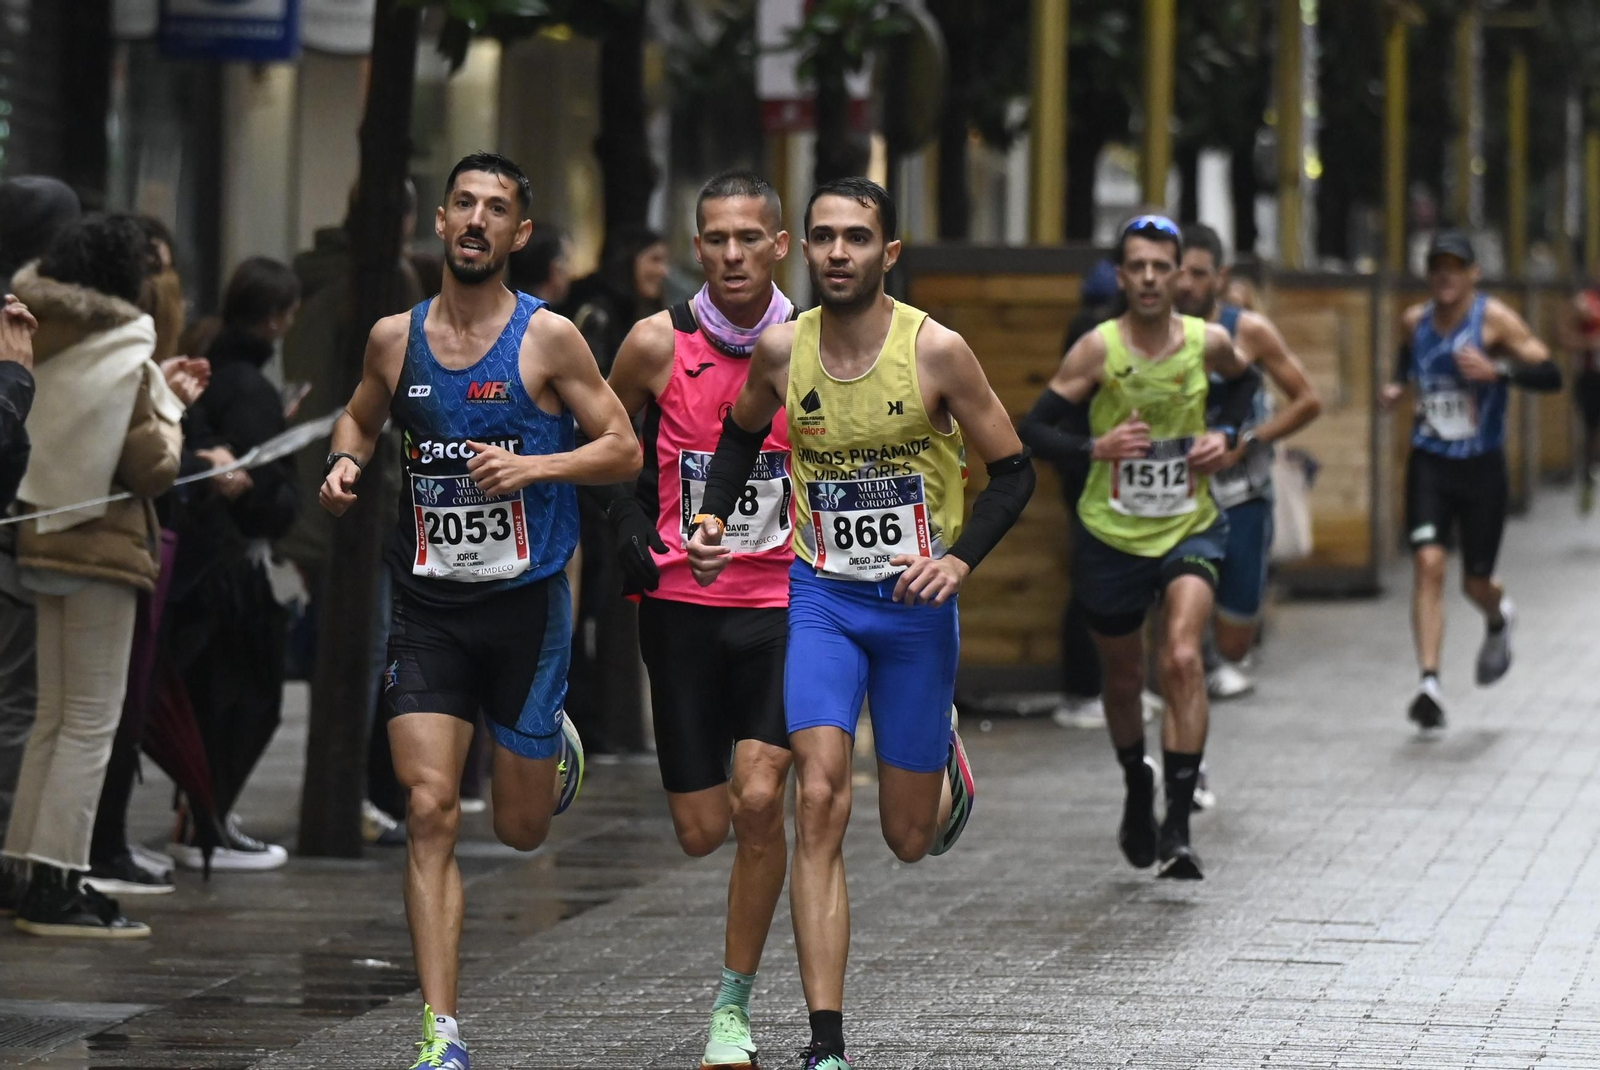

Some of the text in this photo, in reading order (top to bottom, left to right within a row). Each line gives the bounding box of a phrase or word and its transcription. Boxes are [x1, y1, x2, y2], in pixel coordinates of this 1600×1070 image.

[798, 426, 826, 435] valora
[849, 436, 930, 464] PIRÁMIDE
[1122, 462, 1186, 488] 1512
[857, 479, 898, 493] MEDIA
[425, 507, 511, 546] 2053
[725, 524, 749, 532] DAVID
[833, 512, 903, 550] 866
[749, 535, 778, 546] IMDECO
[456, 552, 479, 561] JORGE
[849, 555, 871, 566] DIEGO
[481, 564, 514, 575] IMDECO
